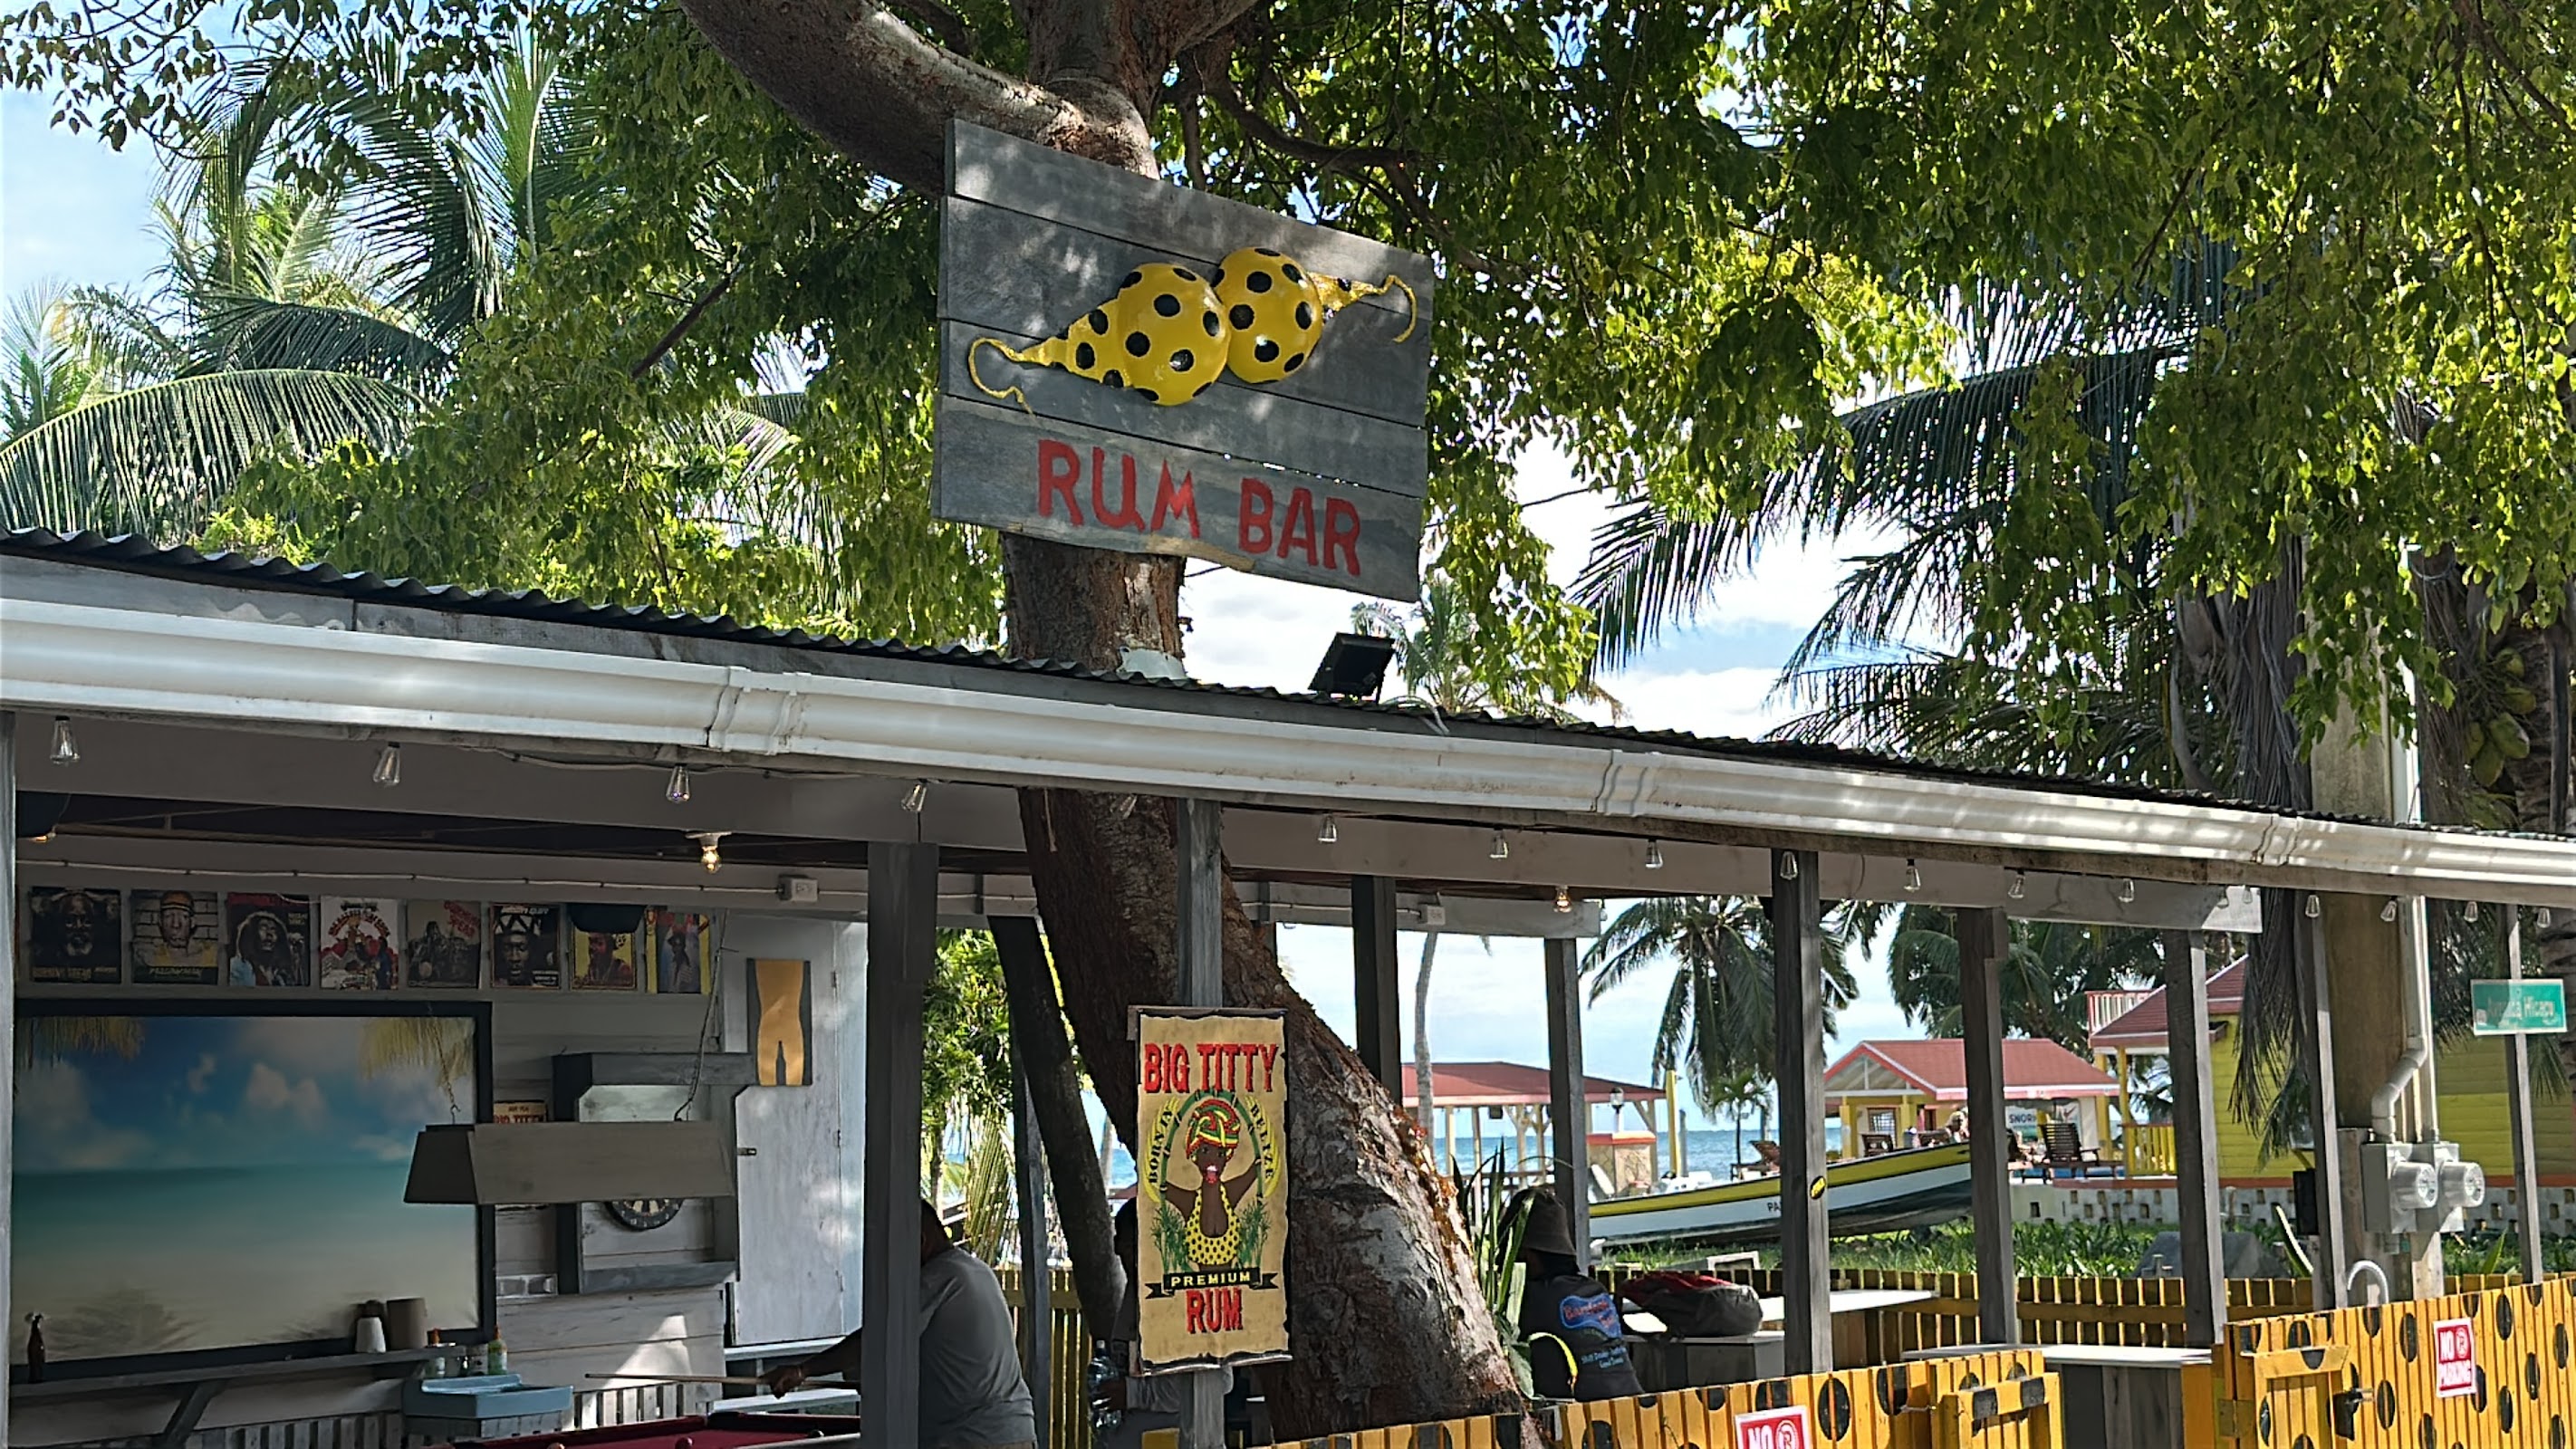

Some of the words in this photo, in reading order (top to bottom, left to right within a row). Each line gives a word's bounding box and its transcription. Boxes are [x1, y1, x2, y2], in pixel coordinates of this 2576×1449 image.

[1038, 438, 1200, 540] RUM
[1238, 477, 1360, 577] BAR
[1144, 1043, 1190, 1093] BIG
[1197, 1043, 1279, 1092] TITTY
[1149, 1132, 1165, 1184] BORN
[1160, 1106, 1174, 1128] IN
[1250, 1104, 1274, 1179] BELIZE
[1170, 1271, 1251, 1288] PREMIUM
[1186, 1286, 1244, 1335] RUM
[2439, 1330, 2455, 1361] NO
[2438, 1359, 2472, 1389] PARKING
